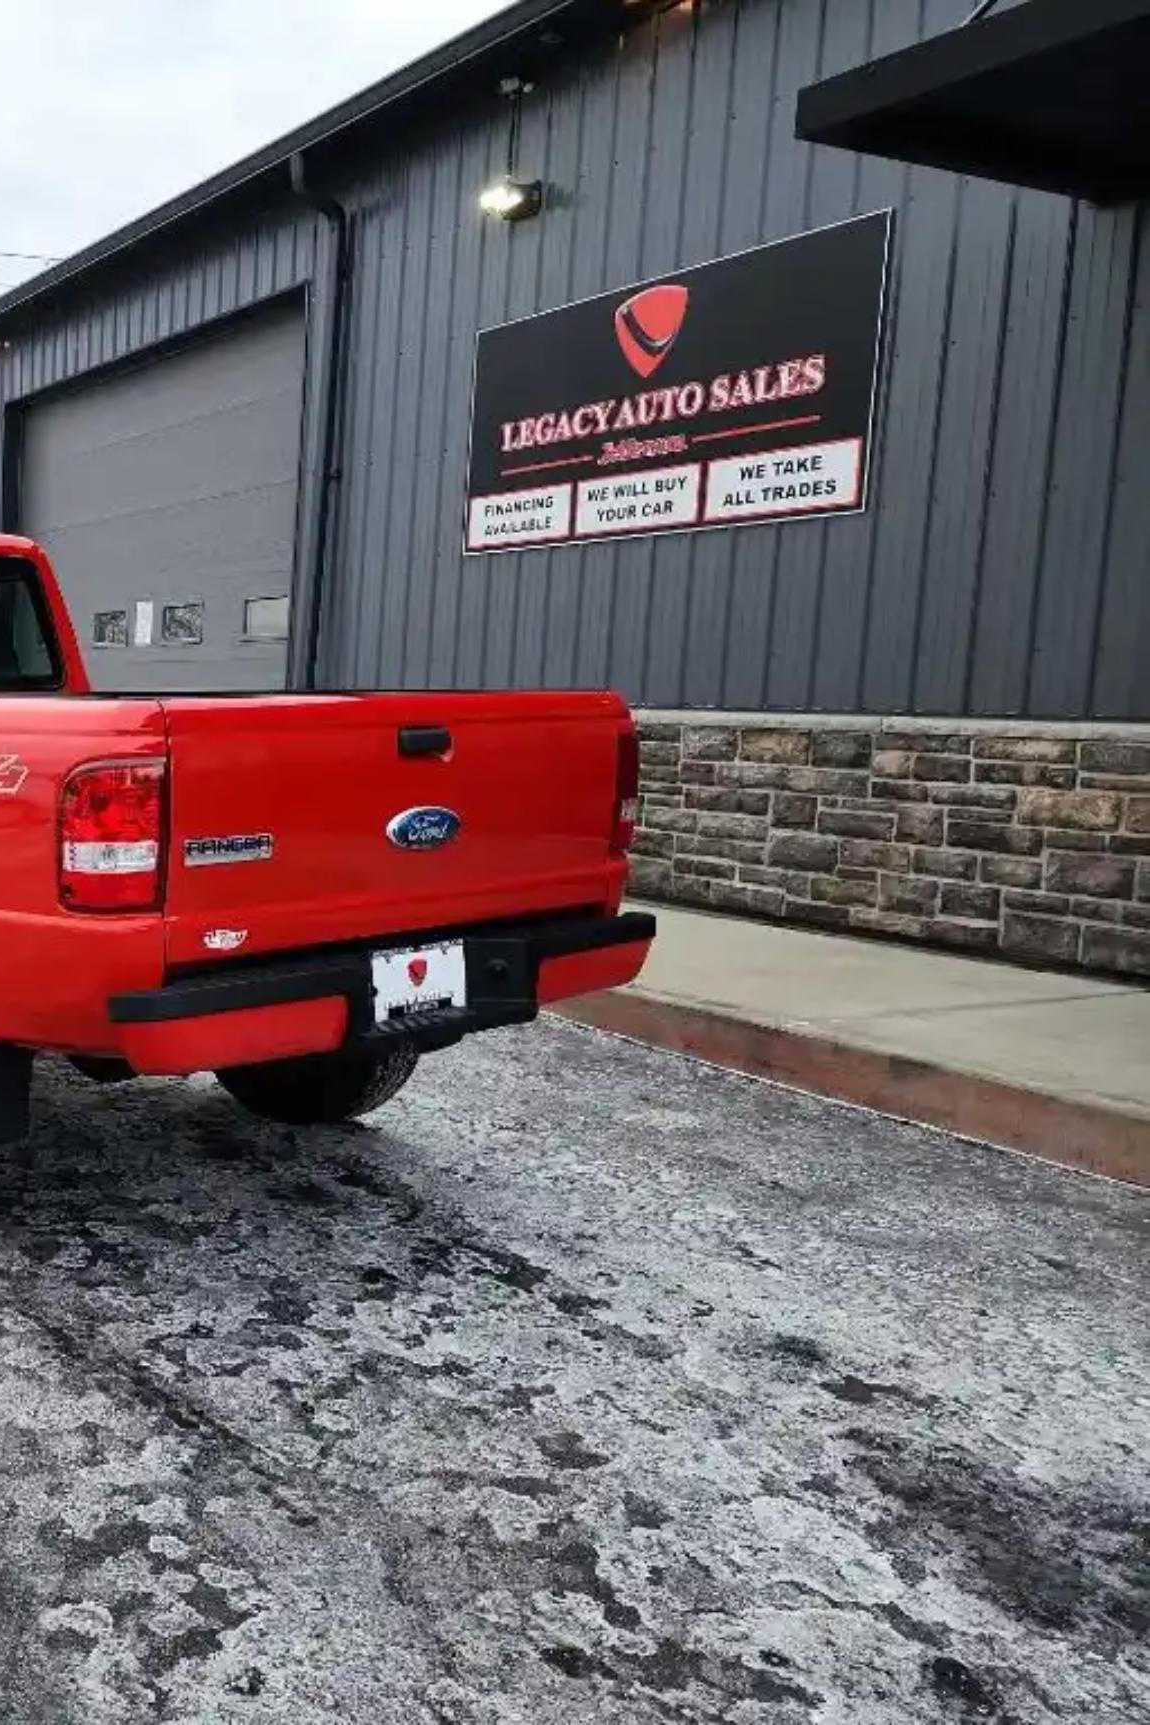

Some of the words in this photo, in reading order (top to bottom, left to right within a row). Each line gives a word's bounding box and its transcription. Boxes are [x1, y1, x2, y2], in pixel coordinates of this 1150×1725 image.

[501, 399, 616, 452] LEGACY
[612, 381, 705, 431] AUTO
[708, 354, 826, 412] SALES
[740, 464, 766, 480] WE
[772, 455, 823, 476] TAKE
[587, 487, 609, 502] WE
[613, 480, 649, 499] WILL
[654, 475, 688, 493] BUY
[723, 490, 756, 506] ALL
[761, 479, 837, 502] TRADES
[484, 495, 554, 517] FINANCING
[597, 504, 637, 522] YOUR
[641, 500, 674, 517] CAR
[484, 515, 553, 536] AVAILABLE
[408, 814, 451, 841] Ford
[186, 835, 271, 857] RANGER
